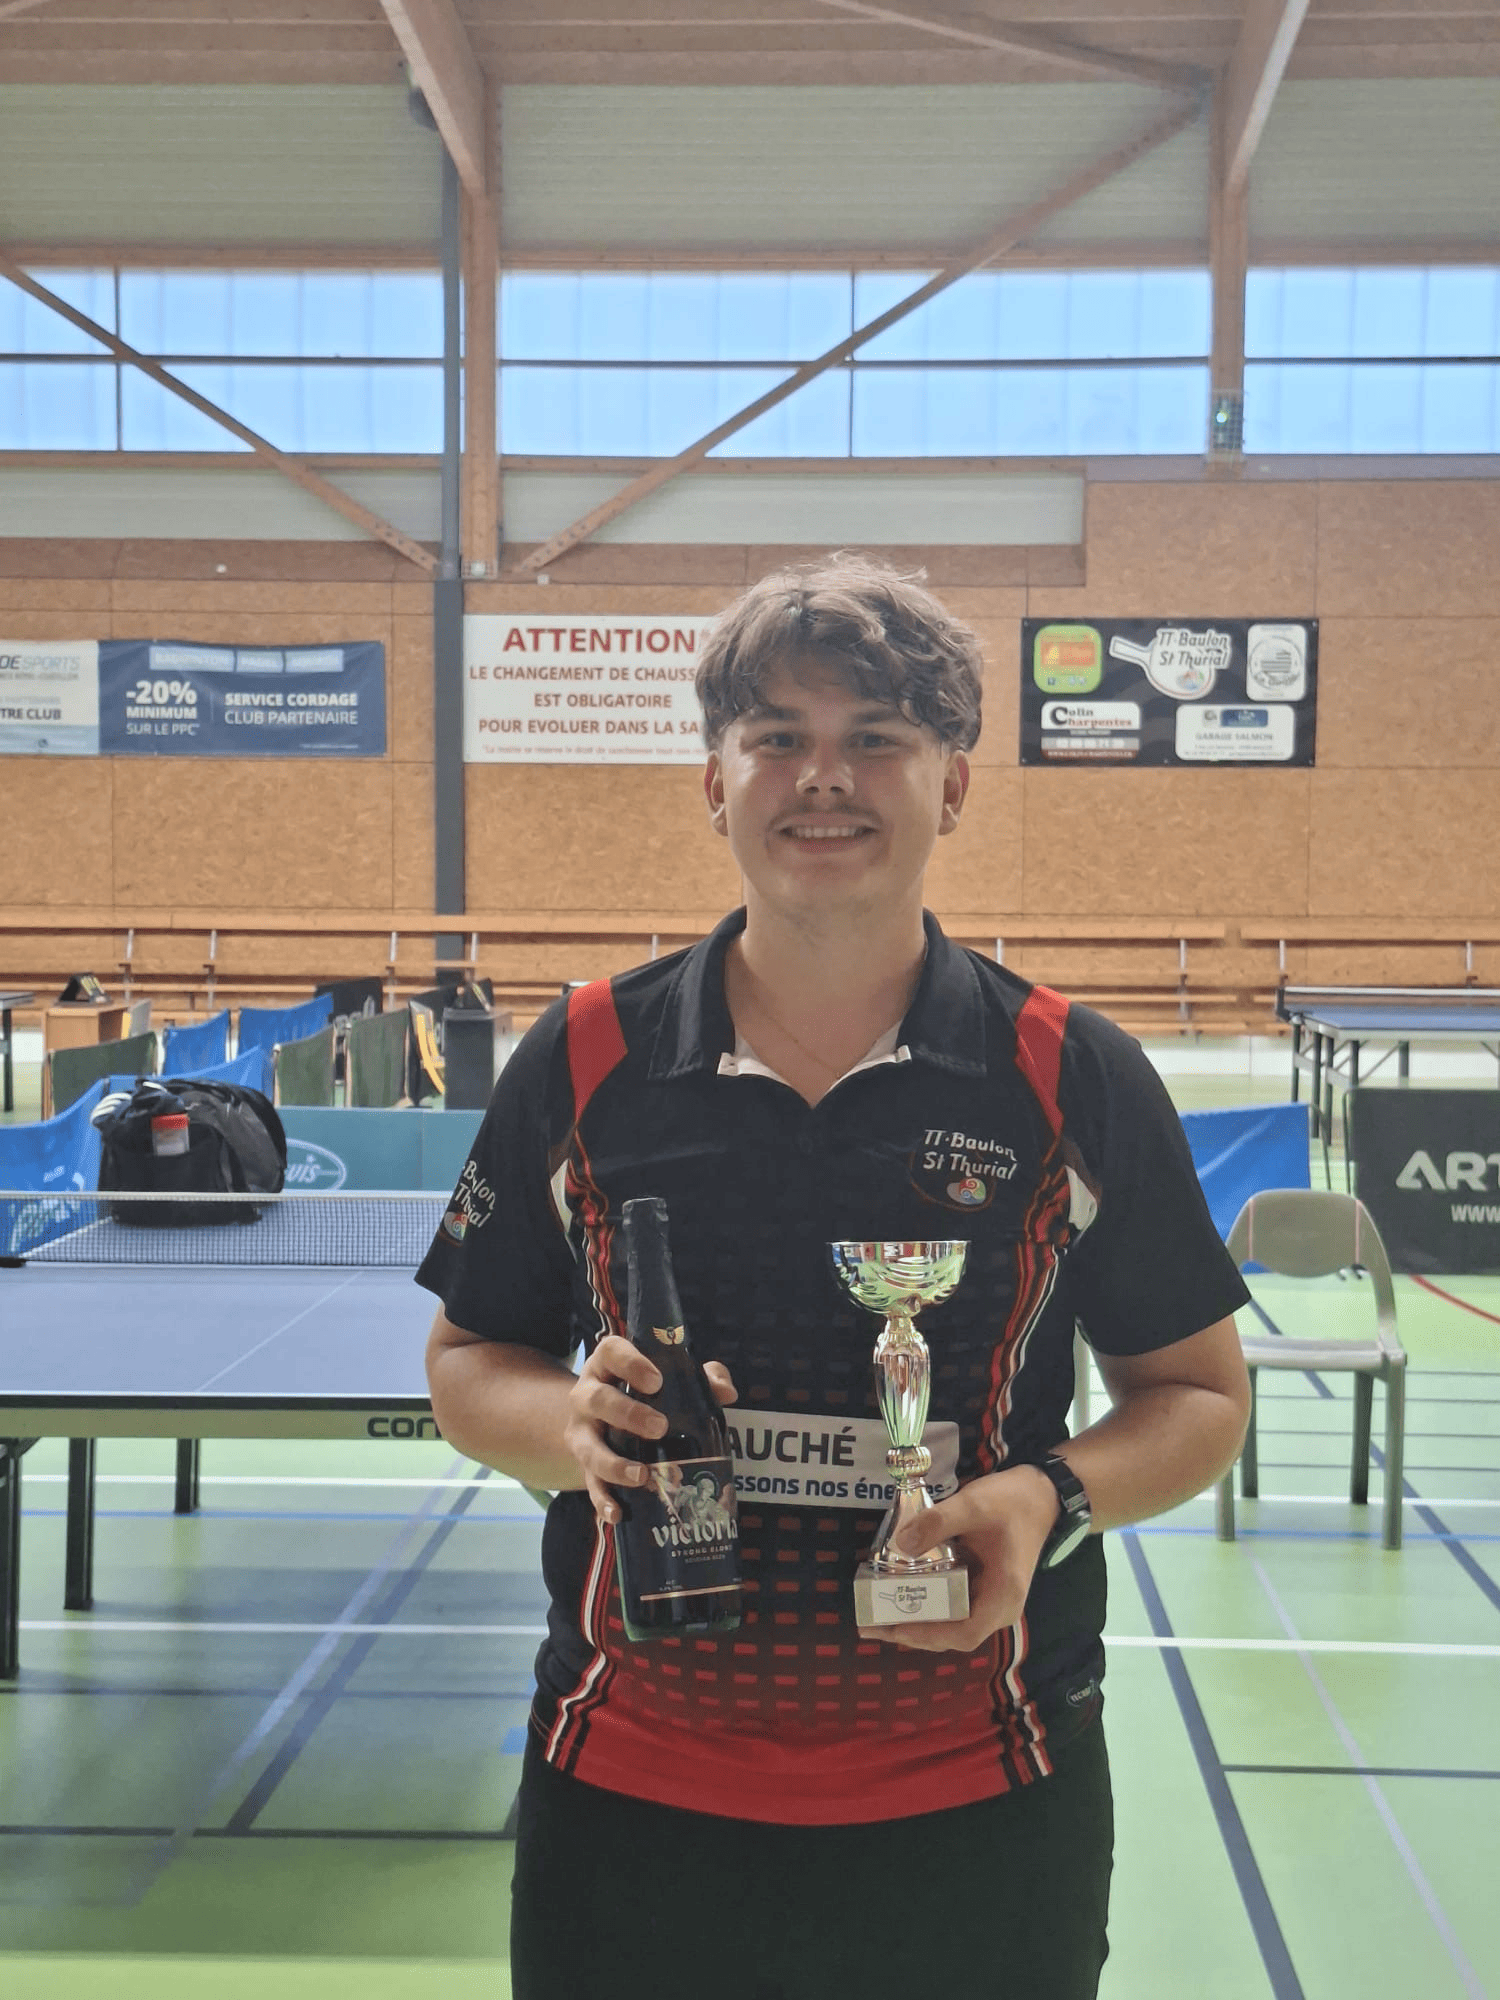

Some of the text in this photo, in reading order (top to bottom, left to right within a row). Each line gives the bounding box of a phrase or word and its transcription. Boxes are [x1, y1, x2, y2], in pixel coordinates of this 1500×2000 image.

[502, 628, 695, 653] ATTENTION
[1179, 631, 1228, 649] Baulon
[1160, 650, 1228, 669] St Thurial
[469, 666, 487, 680] LE
[493, 666, 603, 681] CHANGEMENT
[609, 667, 629, 681] DE
[126, 680, 197, 704] -20%
[225, 693, 358, 707] SERVICE CORDAGE
[534, 694, 672, 708] EST OBLIGATOIRE
[26, 708, 62, 720] CLUB
[126, 706, 197, 719] MINIMUM
[224, 711, 358, 725] CLUB PARTENAIRE
[126, 722, 152, 735] SUR
[154, 723, 169, 736] LE
[479, 720, 522, 734] POUR
[528, 720, 600, 734] EVOLUER
[605, 721, 648, 735] DANS
[654, 721, 674, 735] LA
[951, 1131, 1018, 1162] Baulon
[923, 1151, 1018, 1180] St Thurial
[805, 1479, 849, 1498] nos
